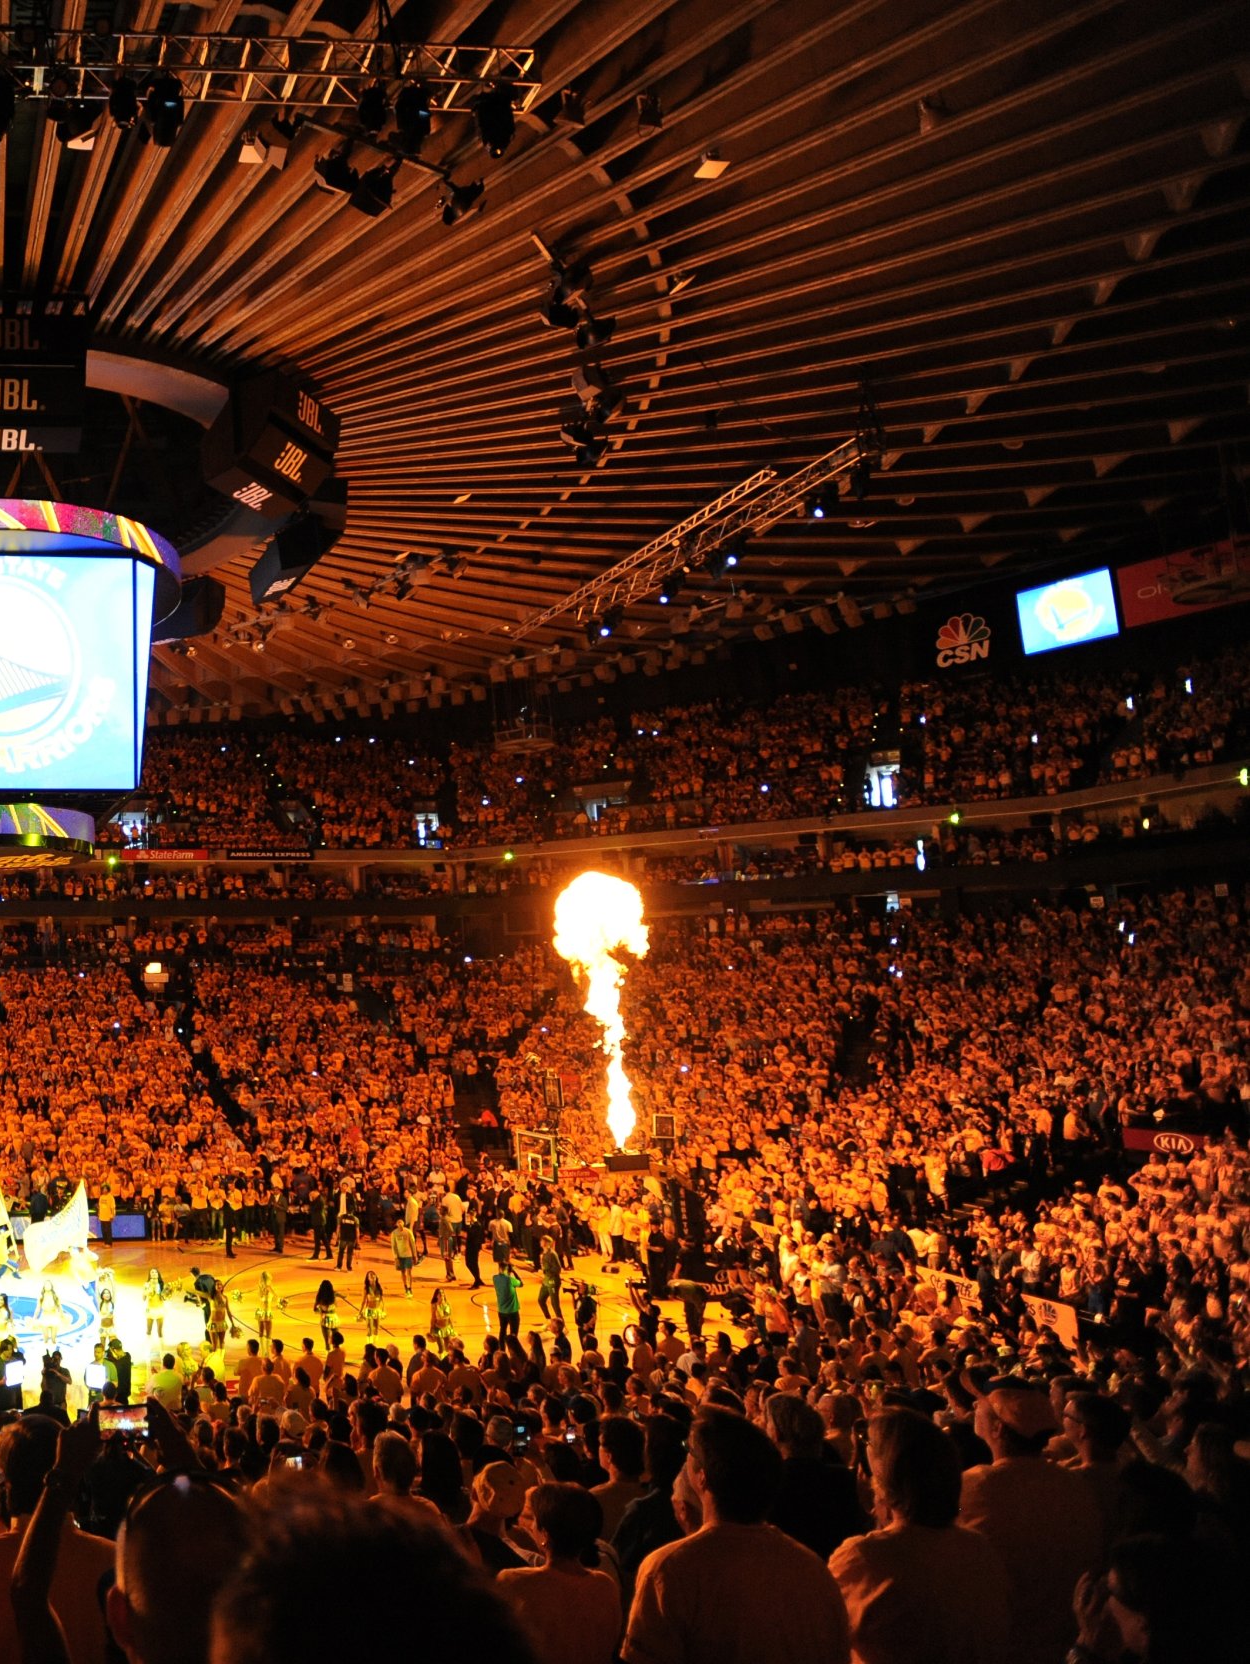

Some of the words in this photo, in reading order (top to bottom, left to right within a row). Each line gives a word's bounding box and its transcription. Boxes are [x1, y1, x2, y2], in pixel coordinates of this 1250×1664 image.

[298, 390, 322, 433] JBL
[274, 441, 308, 481] JBL
[232, 481, 273, 510] JBL
[936, 639, 990, 668] CSN
[1160, 1136, 1188, 1151] KIA
